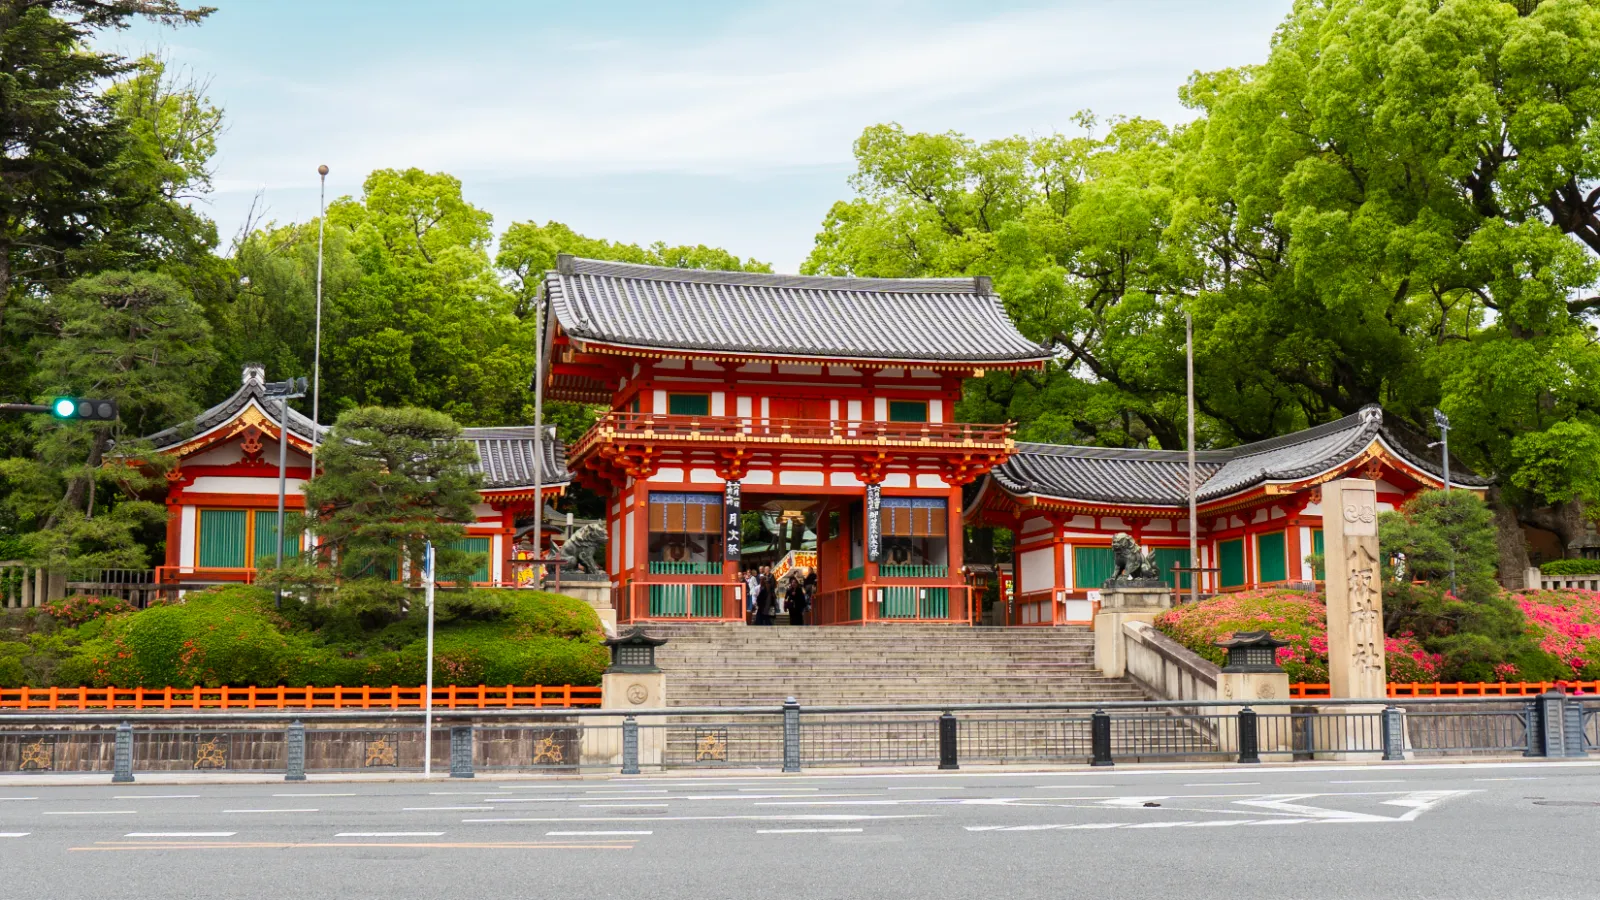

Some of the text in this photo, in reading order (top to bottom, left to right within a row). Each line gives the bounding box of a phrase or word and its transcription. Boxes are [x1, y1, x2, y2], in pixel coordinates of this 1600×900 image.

[727, 513, 740, 556] 月次祭
[1346, 545, 1382, 674] 八坂神社
